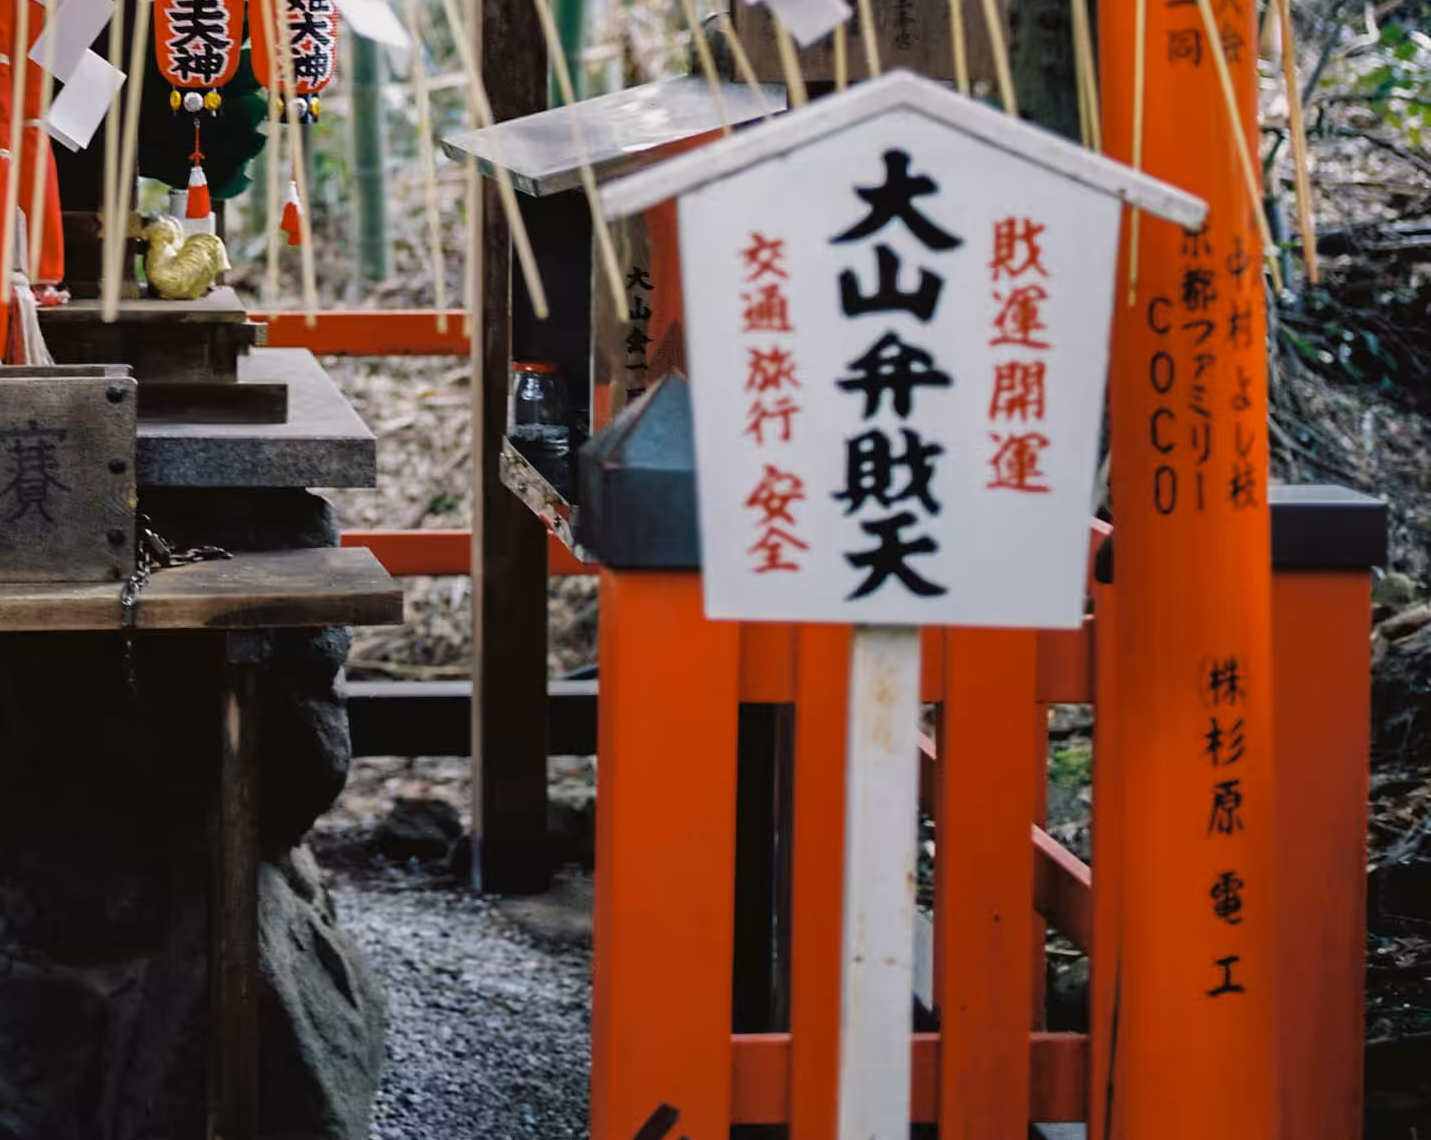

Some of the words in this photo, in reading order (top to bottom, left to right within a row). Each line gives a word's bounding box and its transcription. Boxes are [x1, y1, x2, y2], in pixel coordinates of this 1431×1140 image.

[828, 148, 966, 602] 大山弁財天
[986, 215, 1052, 495] 財運開運
[1146, 296, 1177, 515] COCO
